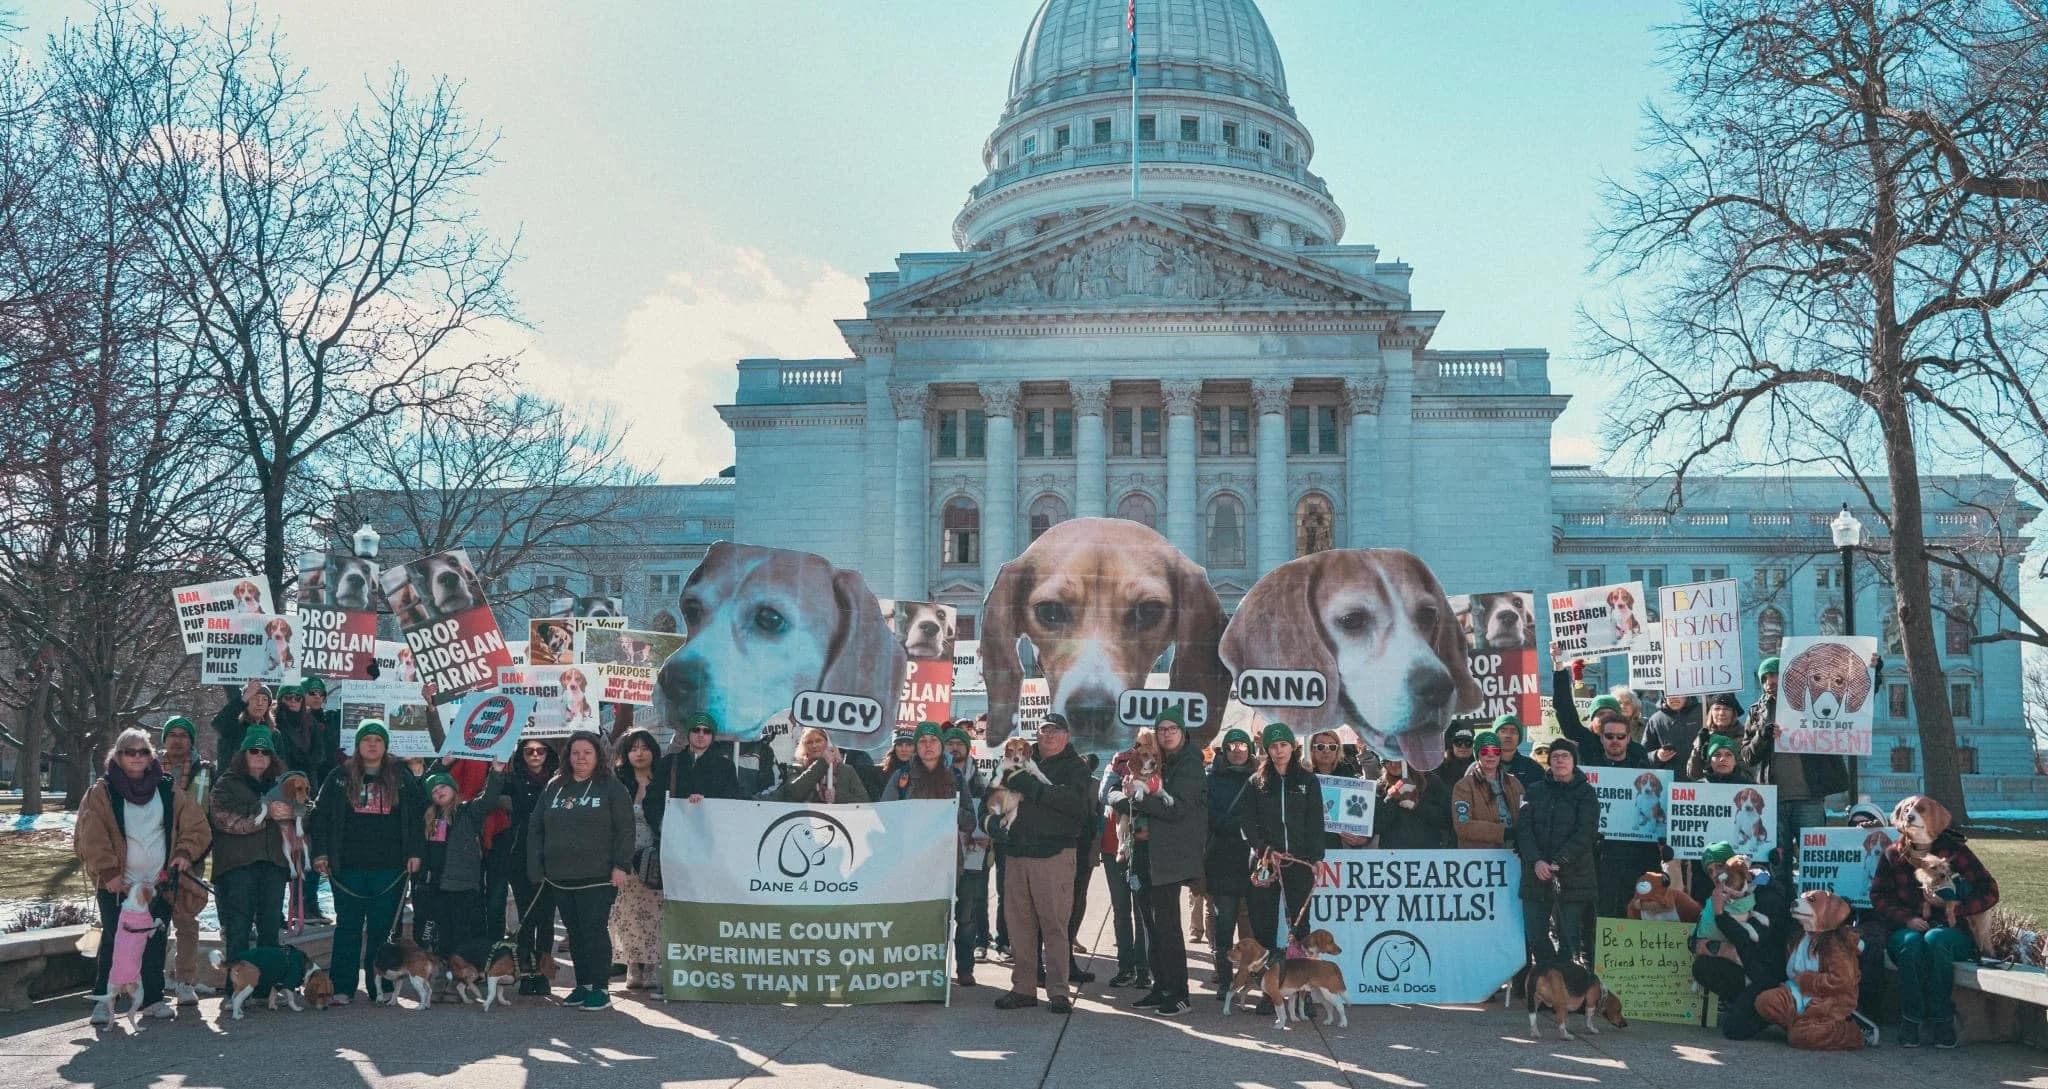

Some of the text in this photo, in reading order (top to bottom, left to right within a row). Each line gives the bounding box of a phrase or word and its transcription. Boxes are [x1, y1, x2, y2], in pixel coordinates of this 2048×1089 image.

[177, 591, 200, 604] BAN
[1552, 597, 1573, 609] BAN
[1673, 586, 1726, 611] BAN
[299, 608, 347, 630] DROP
[1554, 606, 1607, 623] RESEARCH
[207, 618, 230, 630] BAN
[1555, 623, 1588, 637] PUPPY
[1664, 611, 1740, 637] RESEARCH
[206, 632, 263, 645] RESEARCH
[406, 619, 460, 653] DROP
[416, 629, 505, 674] RIDGLAN
[1558, 638, 1588, 651] MILLS
[1680, 640, 1725, 662] PUPPY
[206, 647, 242, 660] PUPPY
[1632, 654, 1663, 666] PUPPY
[205, 662, 238, 674] MILLS
[606, 665, 651, 679] PURPOSE
[1633, 667, 1662, 678] MILLS
[501, 672, 524, 684] BAN
[608, 678, 626, 689] NOT
[1676, 664, 1732, 689] MILLS
[604, 688, 622, 699] NOT
[1241, 676, 1324, 700] ANNA
[800, 698, 877, 728] LUCY
[1799, 719, 1854, 730] I DID NOT
[1776, 727, 1872, 753] CONSENT
[1596, 787, 1633, 800] EARCH
[1671, 788, 1696, 801] BAN
[1671, 803, 1732, 818] RESEARCH
[1671, 820, 1709, 833] PUPPY
[1670, 835, 1705, 848] MILLS
[1804, 834, 1827, 847] BAN
[1803, 849, 1862, 863] RESEARCH
[1346, 861, 1508, 888] RESEARCH
[1802, 866, 1839, 879] PUPPY
[798, 880, 809, 892] 4
[1312, 892, 1496, 922] UPPY MILLS!
[719, 921, 894, 940] DANE COUNTY
[1602, 928, 1684, 949] Be a better
[667, 943, 832, 967] EXPERIMENTS
[839, 947, 876, 966] ON
[1603, 953, 1635, 968] Friend
[1640, 955, 1653, 966] to
[672, 969, 945, 993] DOGS THAN IT ADOPTS
[1393, 983, 1400, 993] 4
